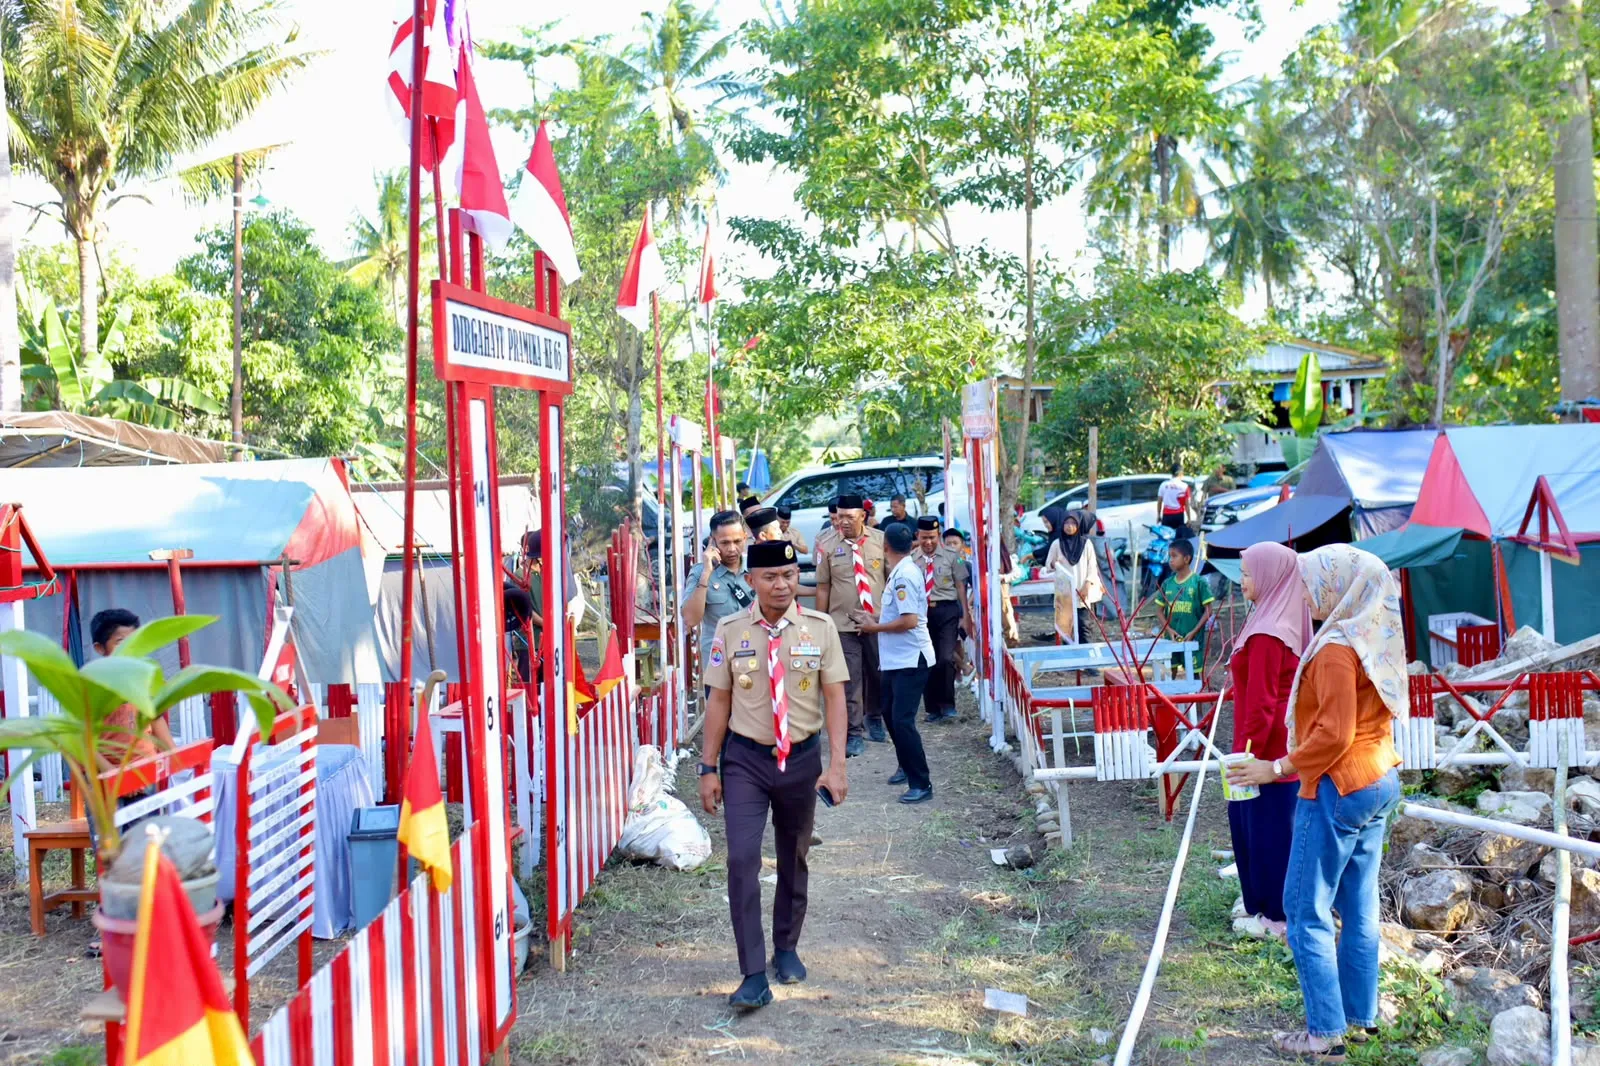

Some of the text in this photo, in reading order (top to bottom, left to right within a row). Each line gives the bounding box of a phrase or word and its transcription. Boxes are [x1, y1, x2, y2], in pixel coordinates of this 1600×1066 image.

[452, 313, 505, 360] DIRGAHAYU
[507, 327, 542, 367] PRAMUKA
[554, 647, 560, 677] 8
[486, 695, 494, 731] 8
[494, 907, 504, 941] 61
